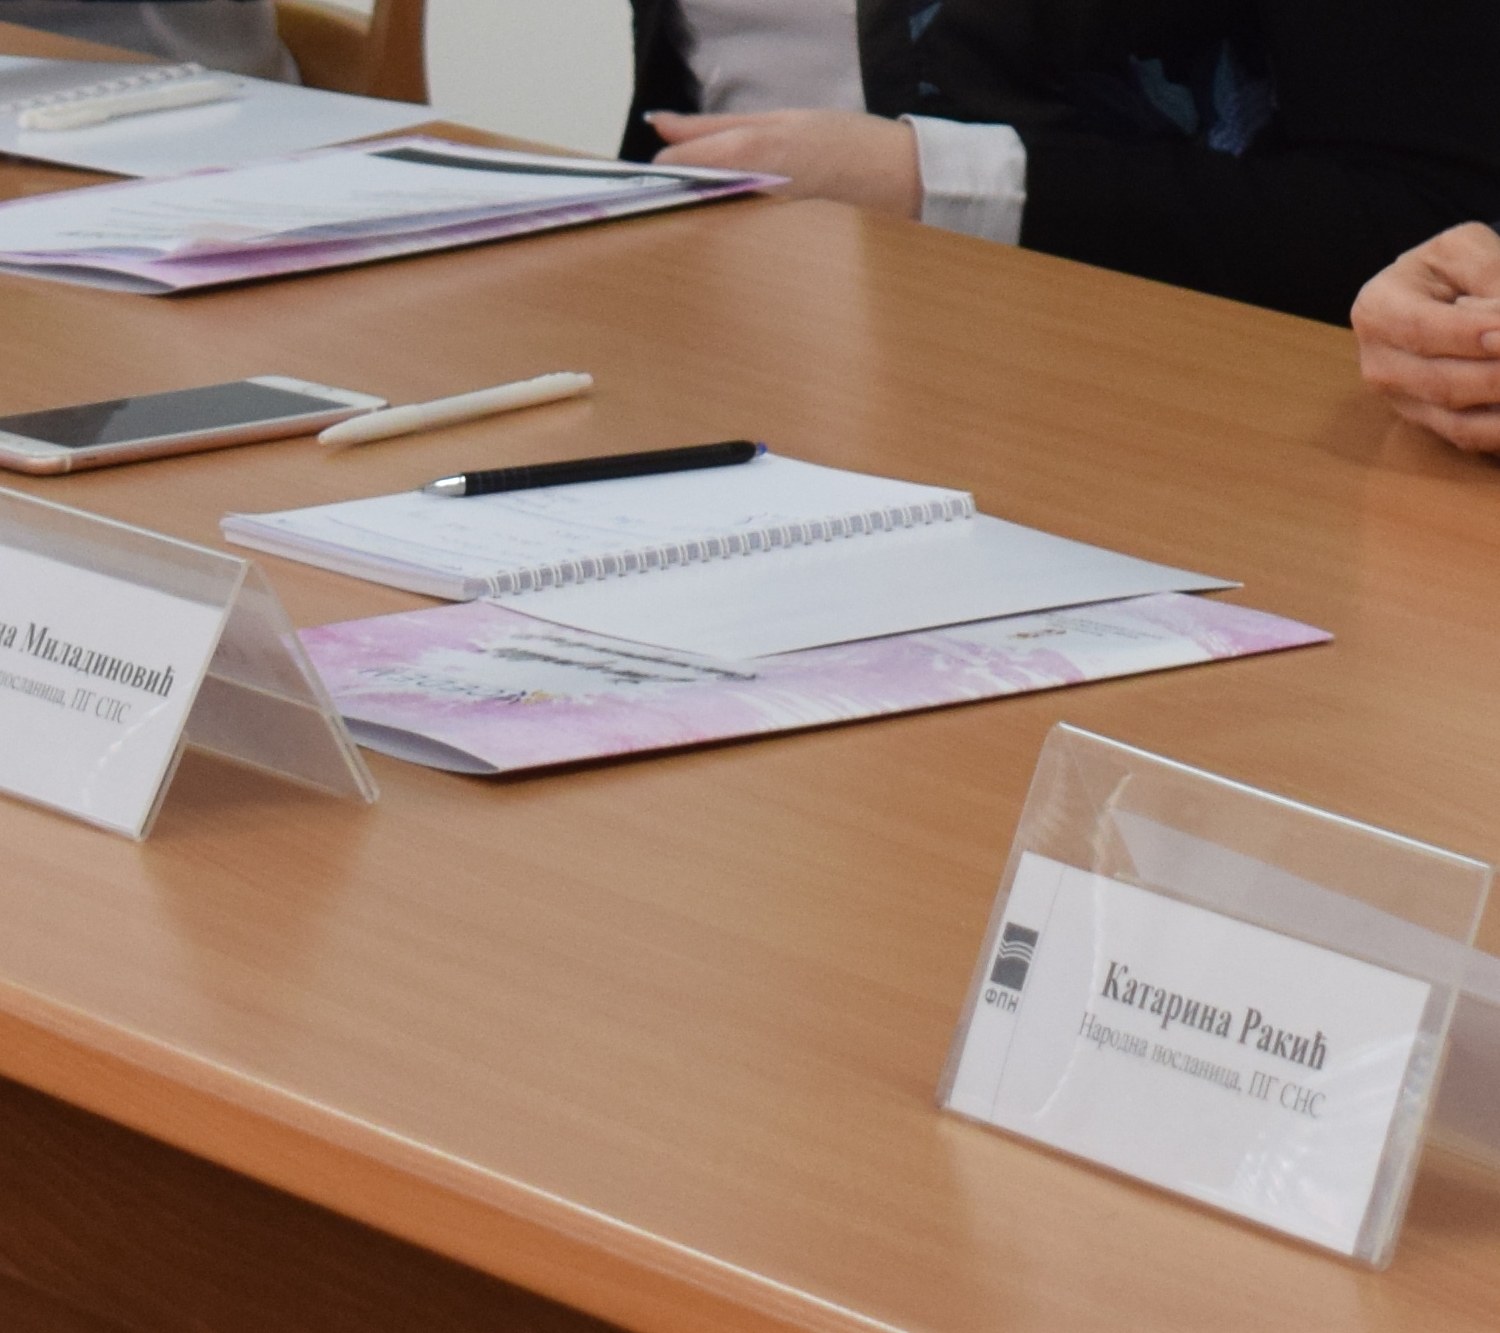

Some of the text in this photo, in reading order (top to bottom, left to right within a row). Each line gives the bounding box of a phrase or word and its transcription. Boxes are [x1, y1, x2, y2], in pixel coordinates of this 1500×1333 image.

[20, 622, 176, 697] Миладиновић
[70, 688, 96, 712] ПГ
[95, 696, 131, 724] СПС
[985, 988, 1019, 1012] ФПН
[1101, 961, 1327, 1070] Катарина Ракић
[1078, 1011, 1148, 1057] Народна
[1248, 1070, 1279, 1101] ПГ
[1280, 1081, 1326, 1119] СНС
